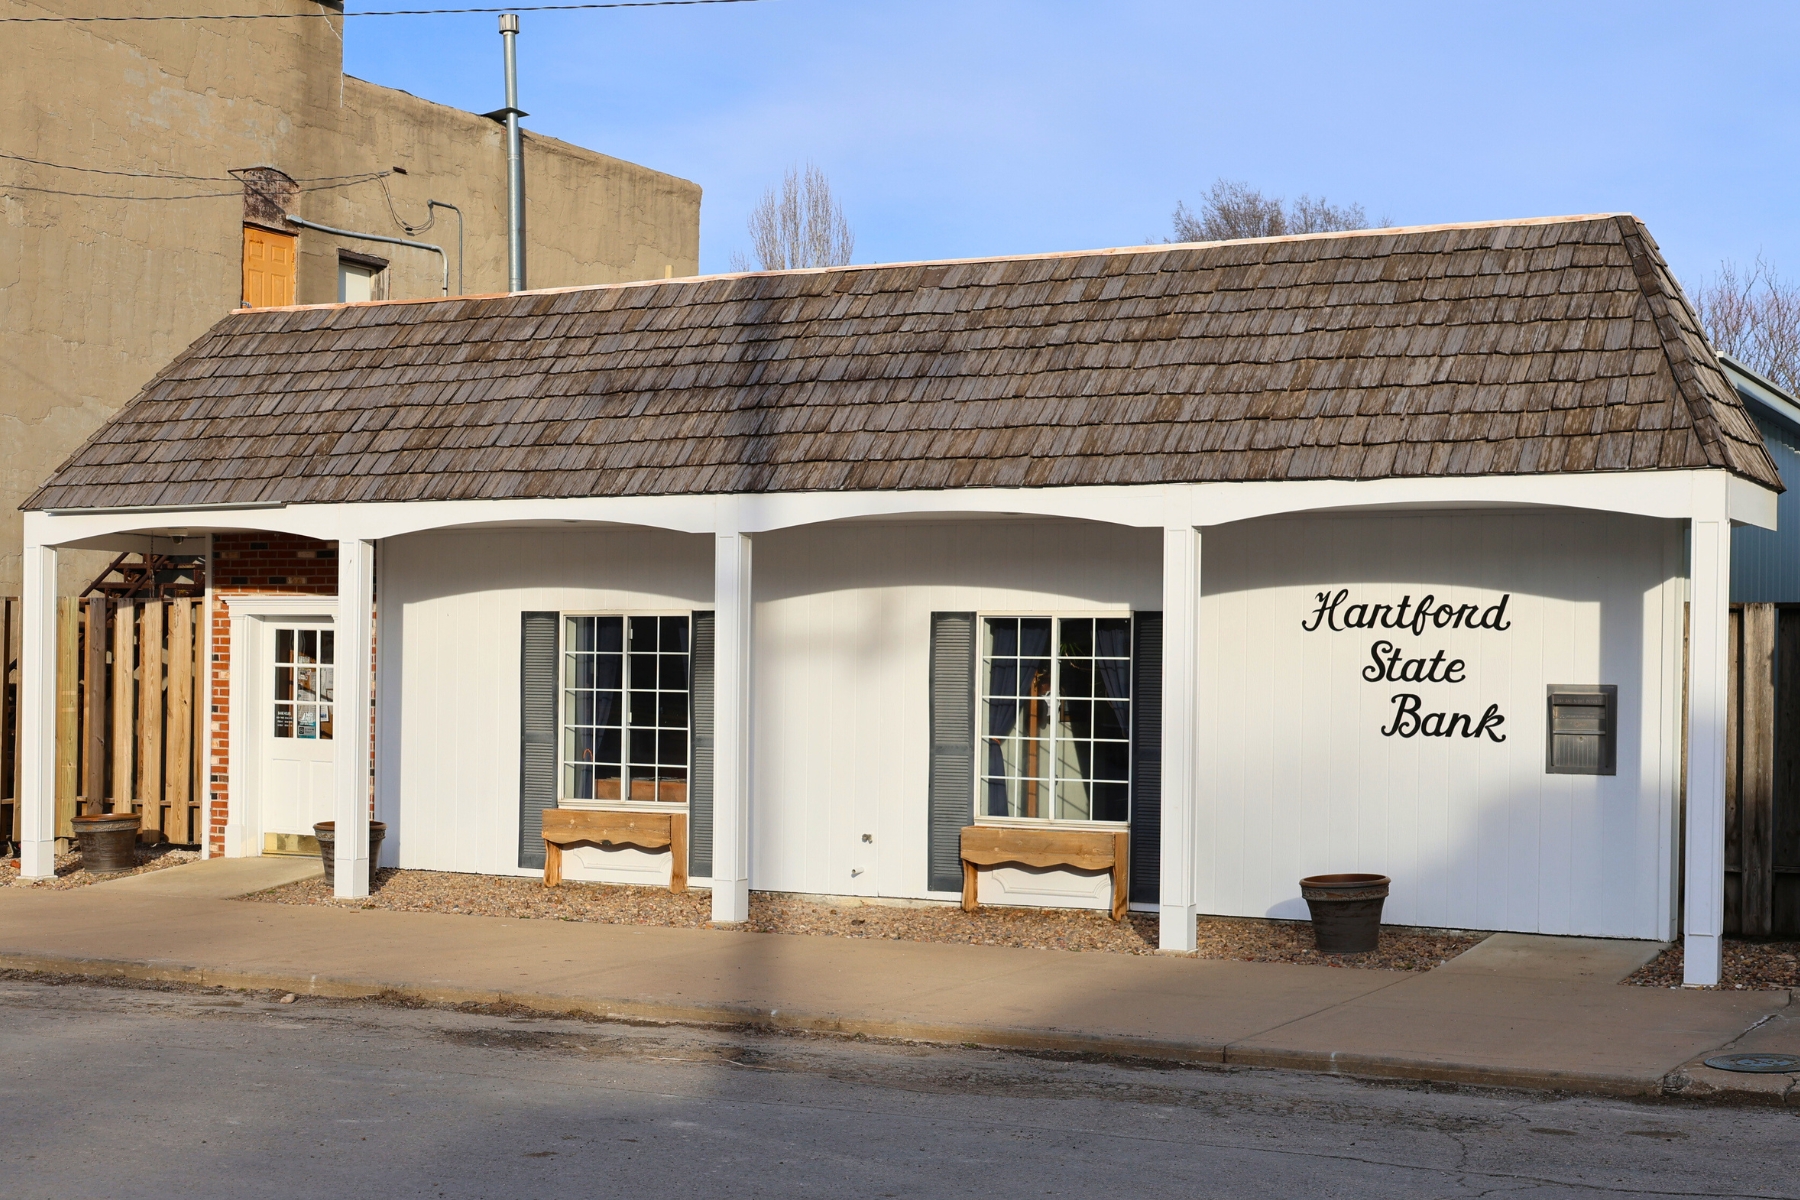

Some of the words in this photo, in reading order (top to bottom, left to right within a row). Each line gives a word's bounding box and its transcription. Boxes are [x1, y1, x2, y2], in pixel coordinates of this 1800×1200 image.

[1301, 588, 1511, 636] Hartford
[1362, 640, 1466, 683] State
[1380, 693, 1507, 743] Bank
